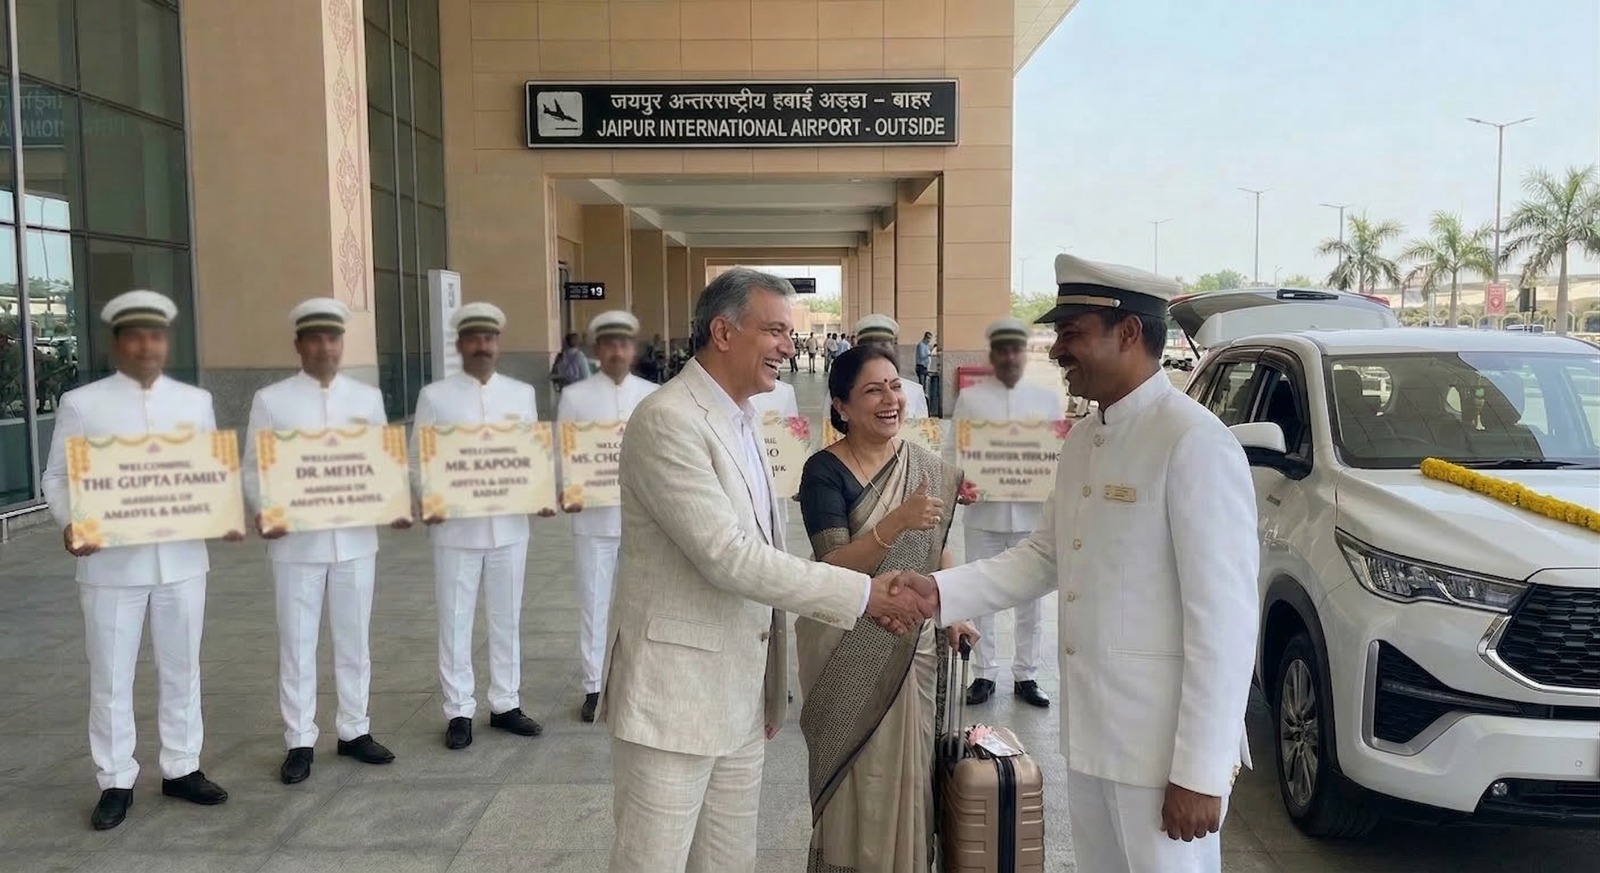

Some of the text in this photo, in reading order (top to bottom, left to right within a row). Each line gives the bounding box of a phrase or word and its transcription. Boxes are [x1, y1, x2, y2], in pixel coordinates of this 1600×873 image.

[611, 94, 663, 115] जयपुर
[669, 87, 766, 113] अन्तरराष्ट्रीय
[891, 92, 932, 110] बाहर
[597, 119, 656, 137] JAIPUR
[660, 118, 787, 137] INTERNATIONAL
[790, 118, 861, 137] AIRPORT
[875, 117, 945, 136] OUTSIDE
[296, 464, 375, 479] DR. MEHTA
[445, 457, 531, 472] MR. KAPOOR
[82, 471, 228, 491] THE GUPTA FAMILY
